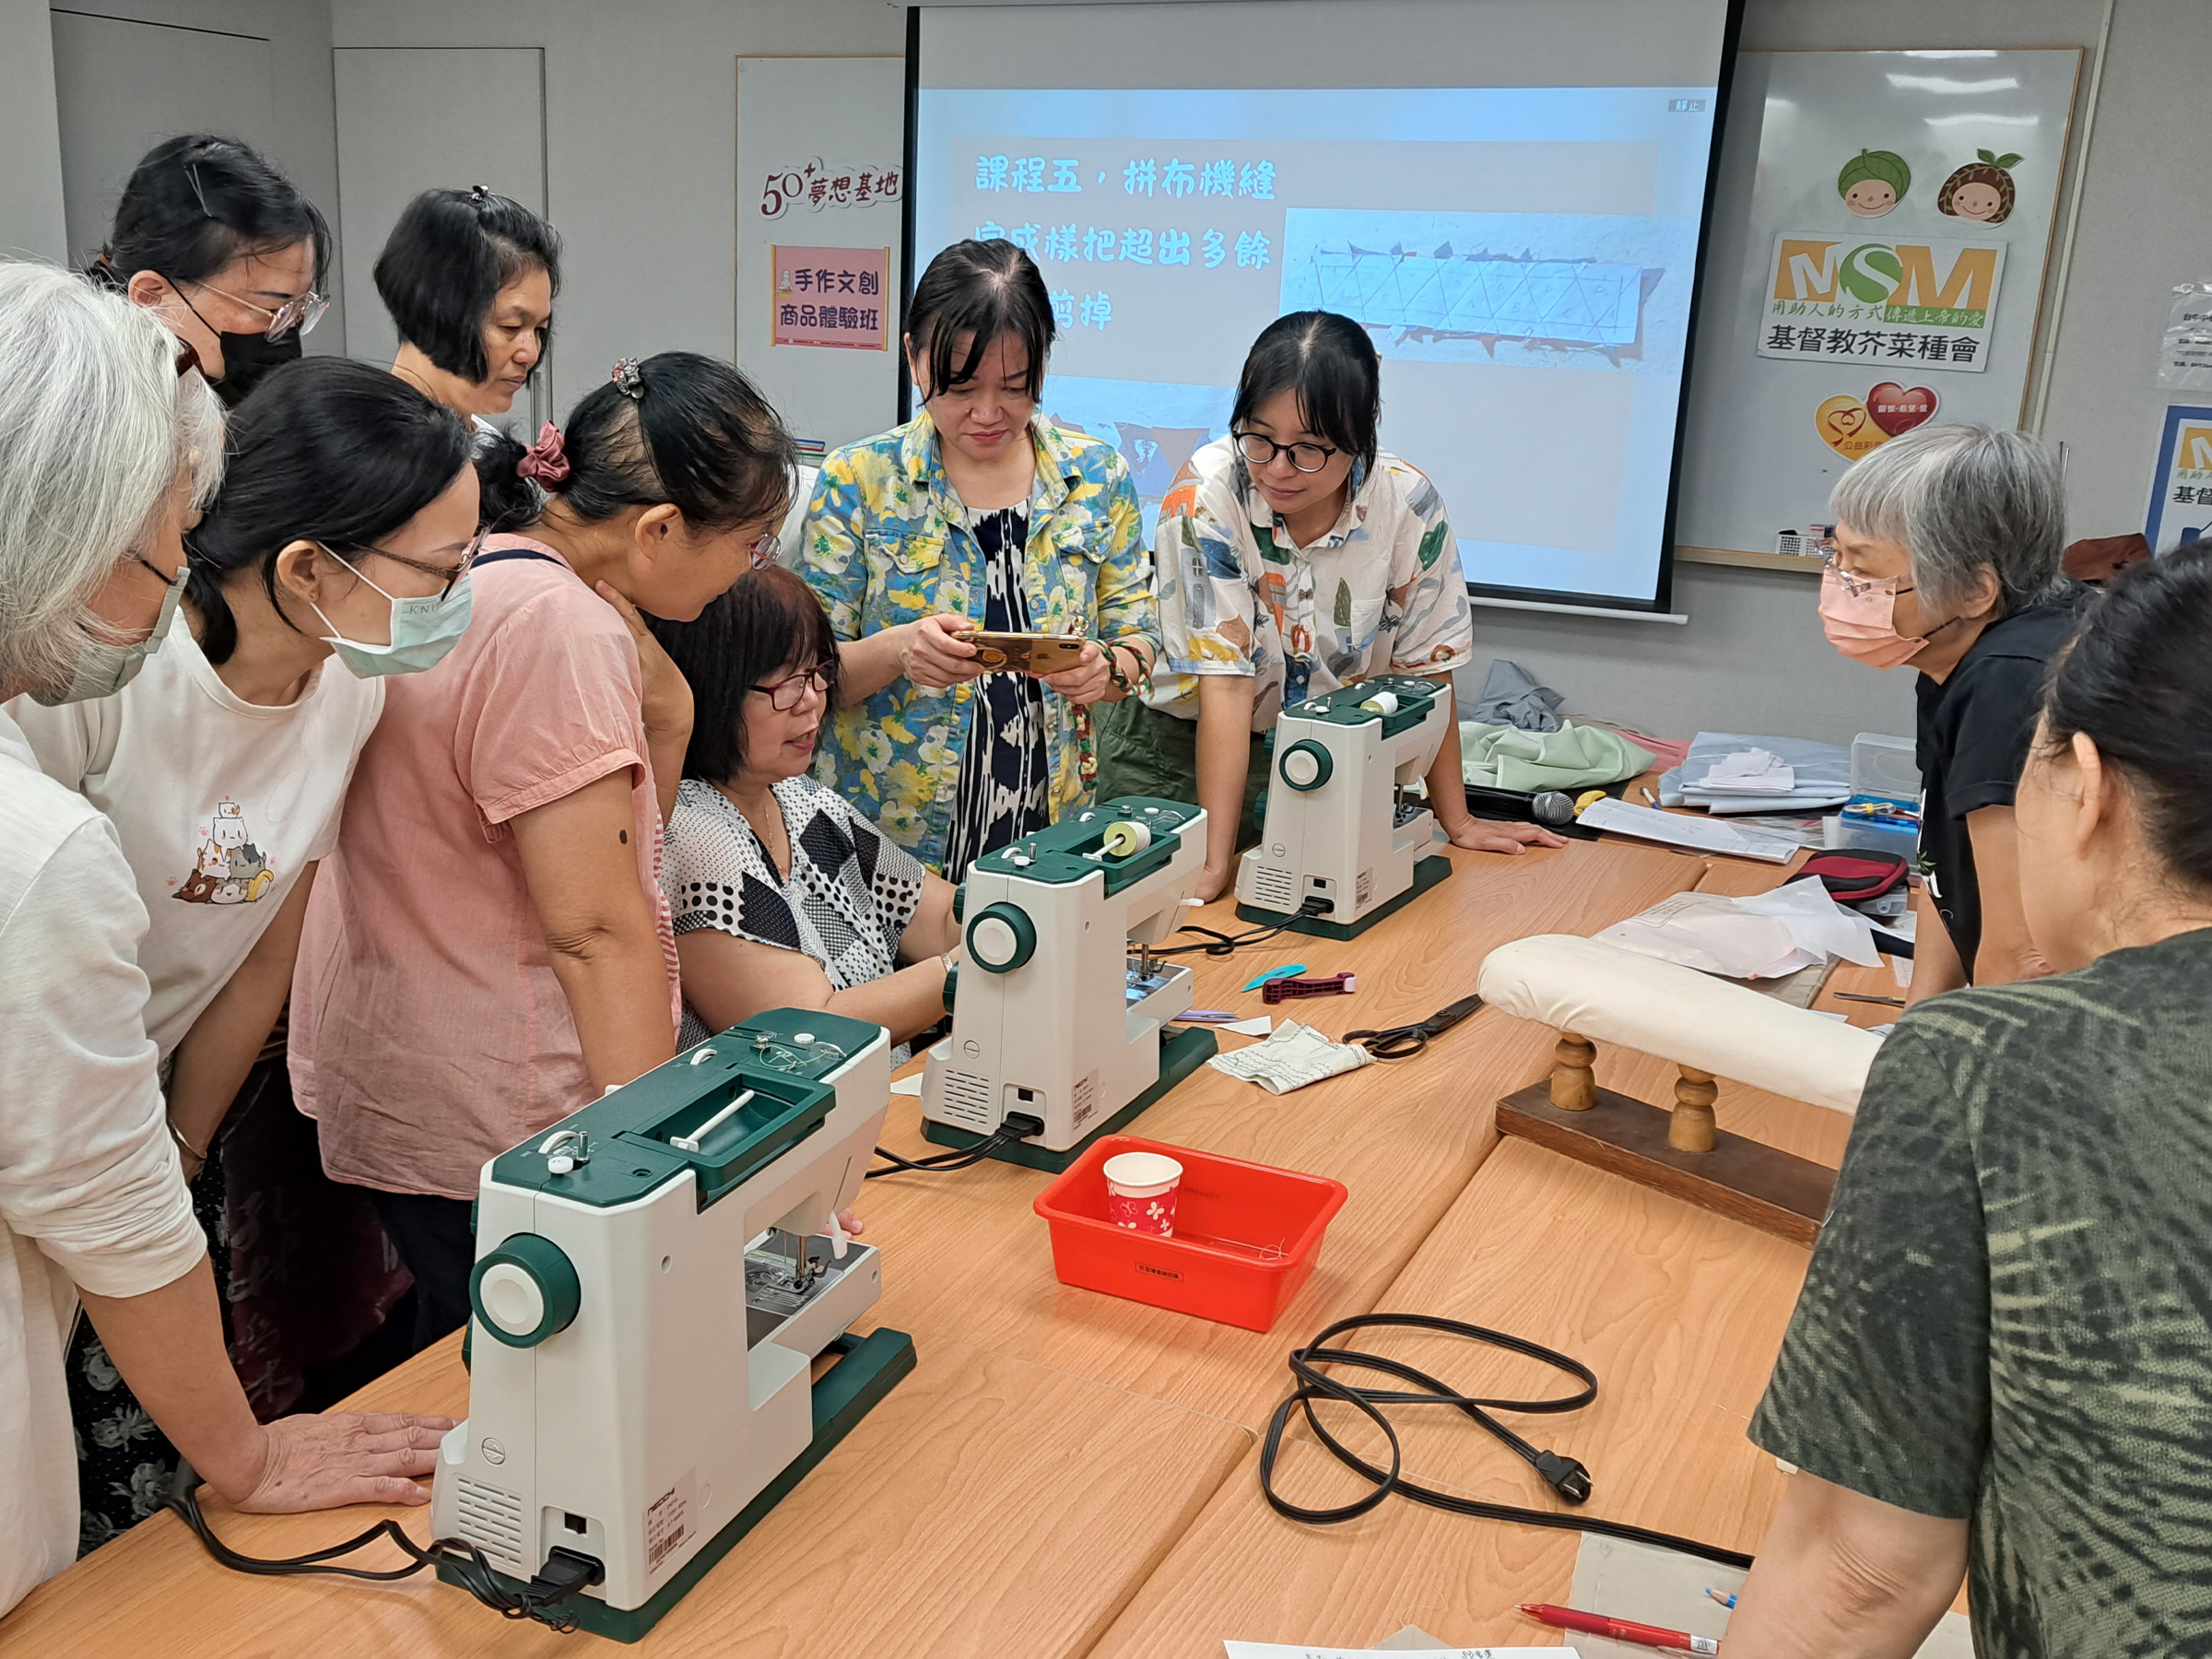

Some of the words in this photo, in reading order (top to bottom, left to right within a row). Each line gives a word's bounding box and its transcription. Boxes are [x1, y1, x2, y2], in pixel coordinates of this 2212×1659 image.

[794, 268, 879, 295] 手作文創
[1773, 240, 1998, 311] NSM
[780, 303, 878, 331] 商品體驗班
[1767, 324, 1981, 363] 基督教芥菜種會
